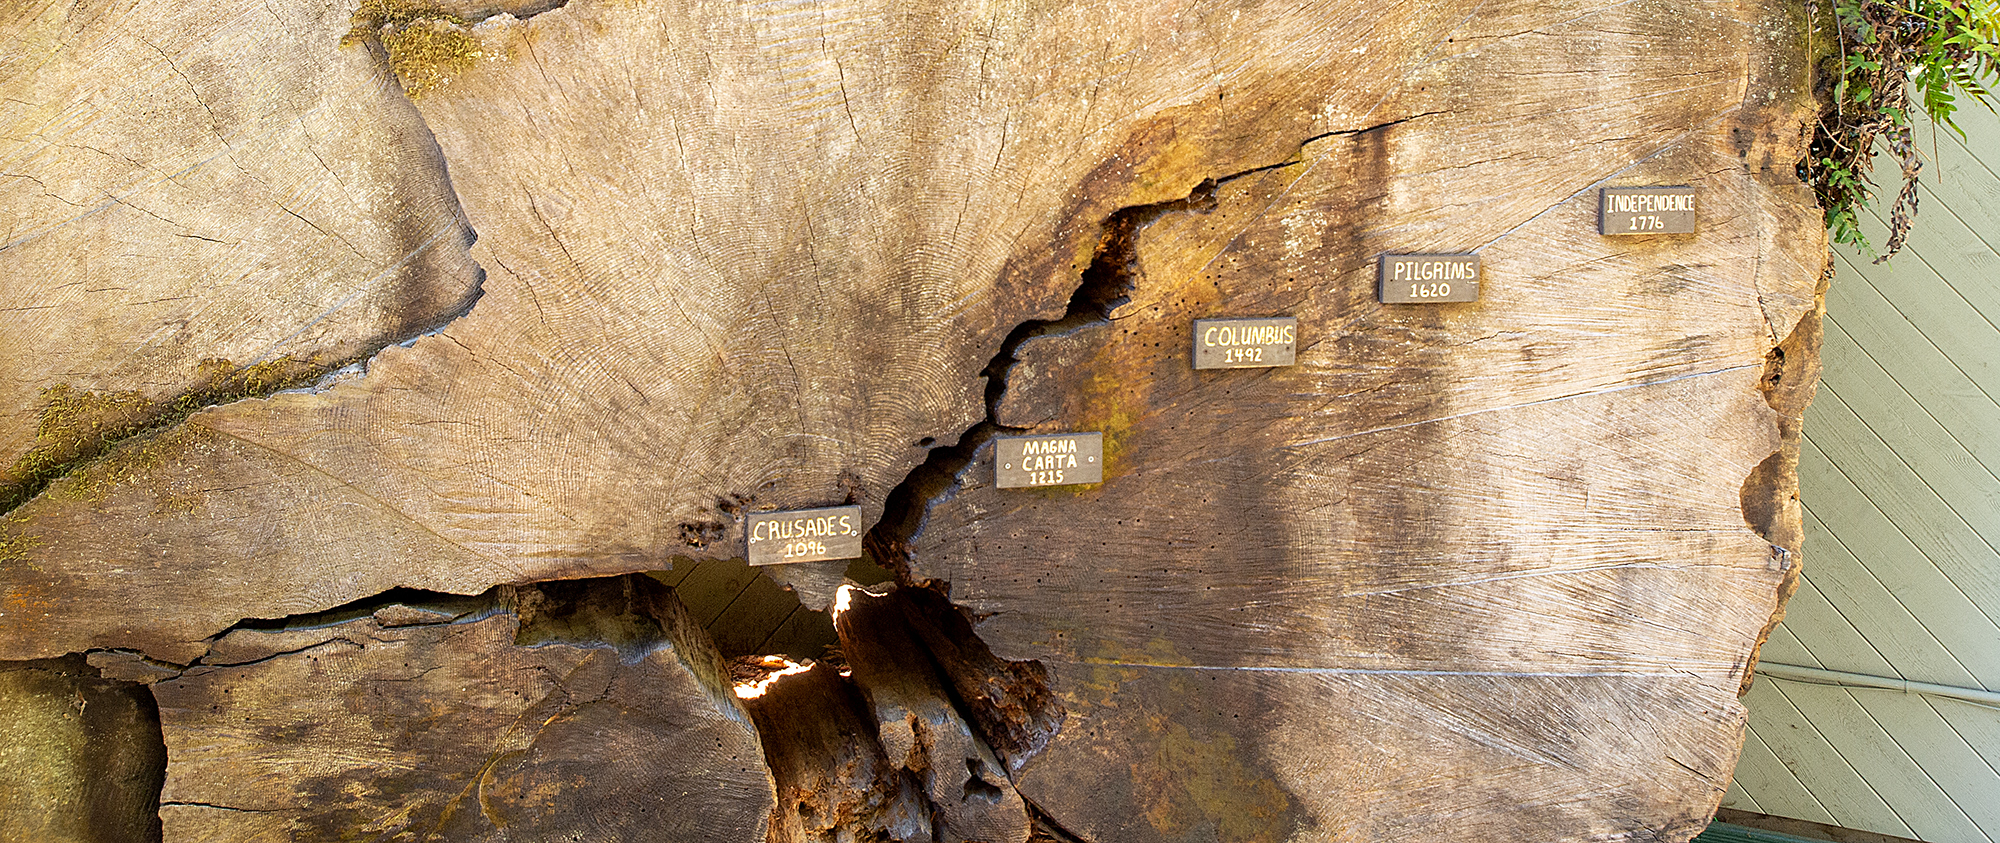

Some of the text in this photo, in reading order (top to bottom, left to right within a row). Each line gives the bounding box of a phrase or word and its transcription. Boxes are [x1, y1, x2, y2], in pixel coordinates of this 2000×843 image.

[1607, 194, 1695, 213] INDEPENDENCE
[1629, 215, 1665, 231] 1776
[1394, 261, 1475, 280] PILGRIMS
[1409, 282, 1451, 298] 1620
[1204, 325, 1294, 347] COLUMBUS
[1224, 347, 1262, 363] 1492
[1022, 439, 1077, 455] MAGNA
[1022, 454, 1077, 471] CARTA
[1030, 470, 1064, 485] 1215
[753, 515, 852, 541] CRUSADES
[784, 541, 826, 558] 1096
